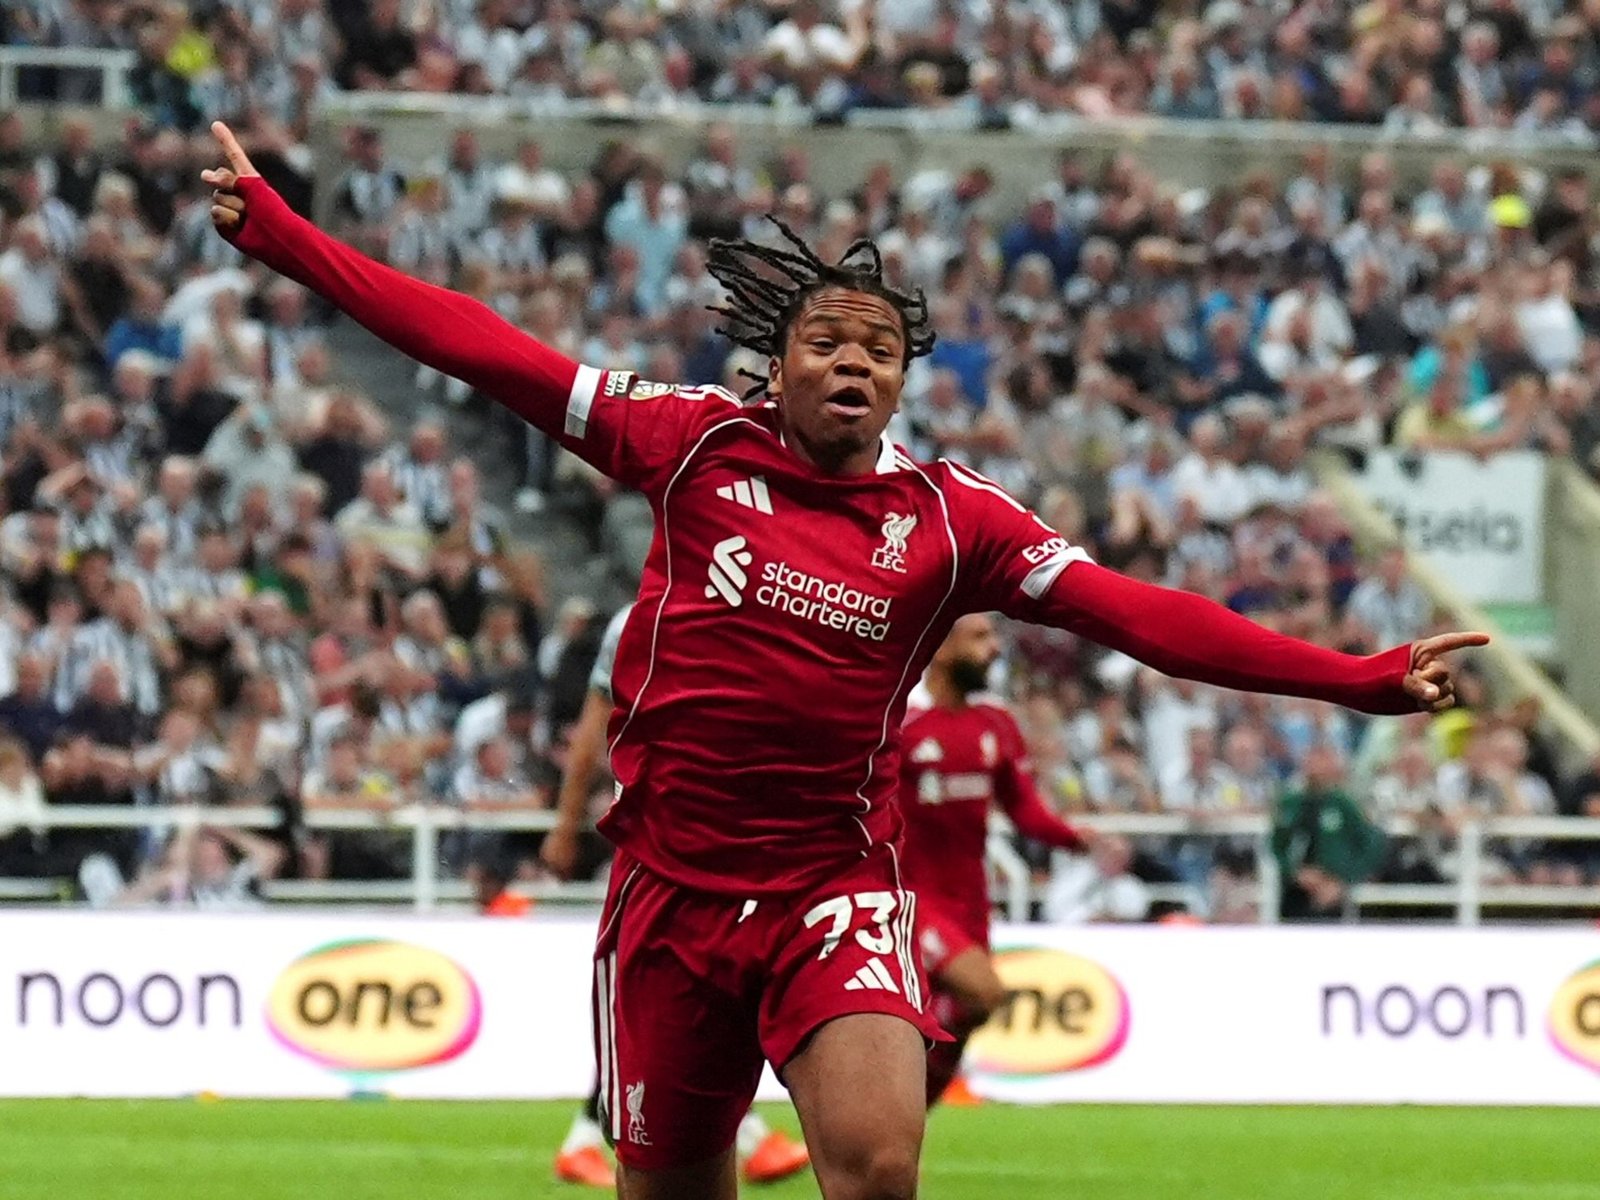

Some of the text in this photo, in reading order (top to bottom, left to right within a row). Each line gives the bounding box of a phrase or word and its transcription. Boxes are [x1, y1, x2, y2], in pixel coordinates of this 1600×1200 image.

[756, 585, 892, 641] chartered
[761, 561, 892, 619] standard
[802, 888, 898, 961] 73
[18, 972, 442, 1029] noon one
[998, 987, 1094, 1034] ne
[1320, 984, 1526, 1037] noon
